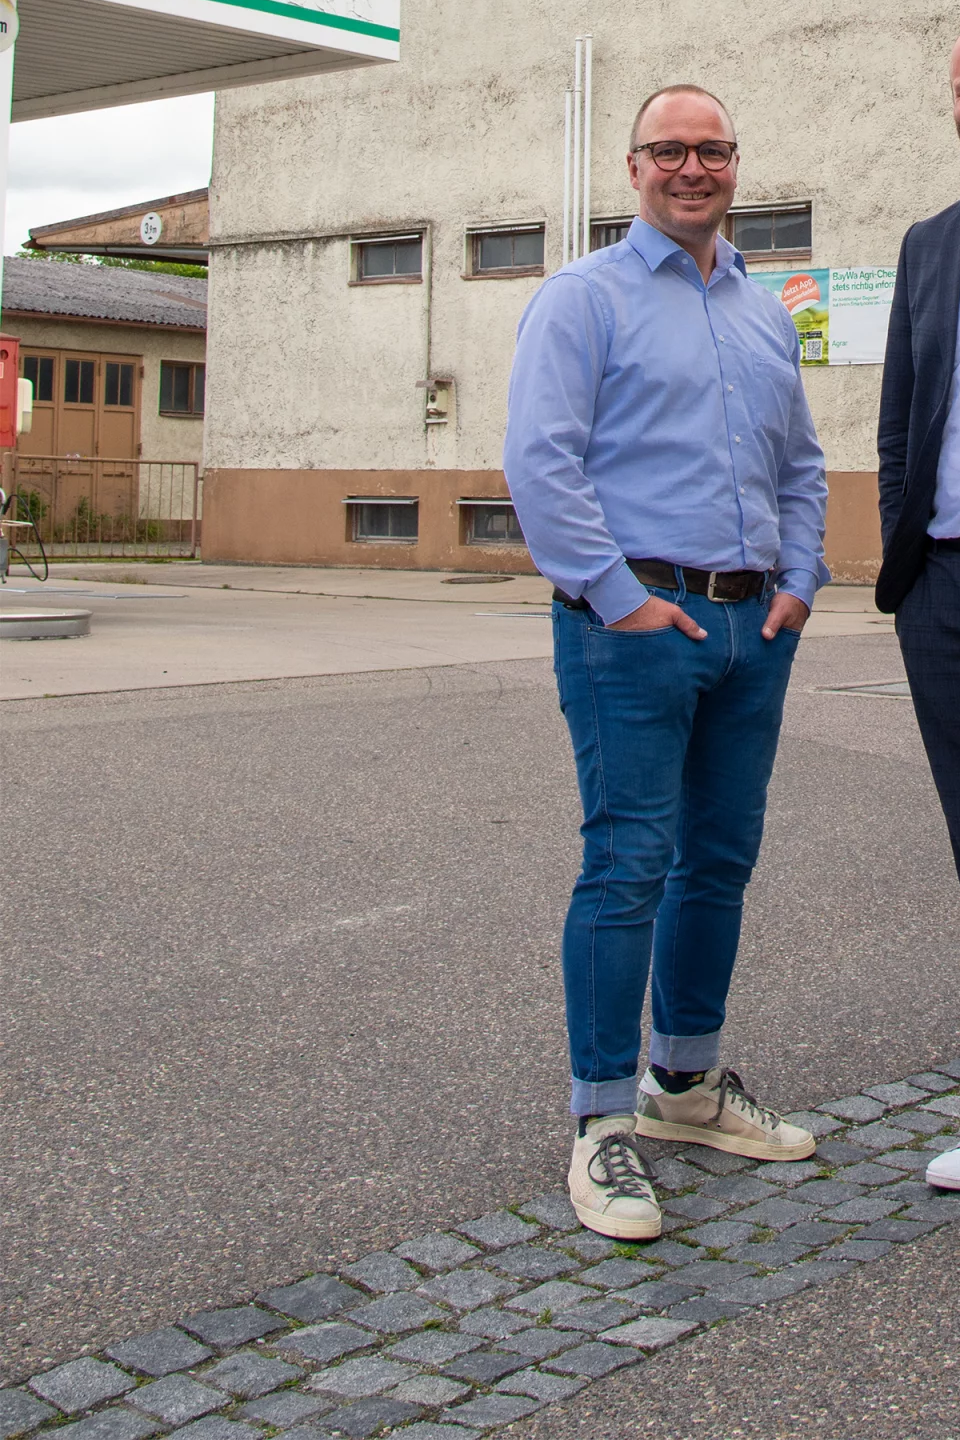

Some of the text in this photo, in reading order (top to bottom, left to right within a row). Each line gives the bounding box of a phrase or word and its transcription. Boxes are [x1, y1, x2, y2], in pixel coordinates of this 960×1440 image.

[832, 271, 858, 282] BayWa
[783, 278, 813, 298] Jetzt App
[832, 283, 850, 291] stets
[851, 281, 873, 291] richtig
[831, 340, 848, 348] Agrar
